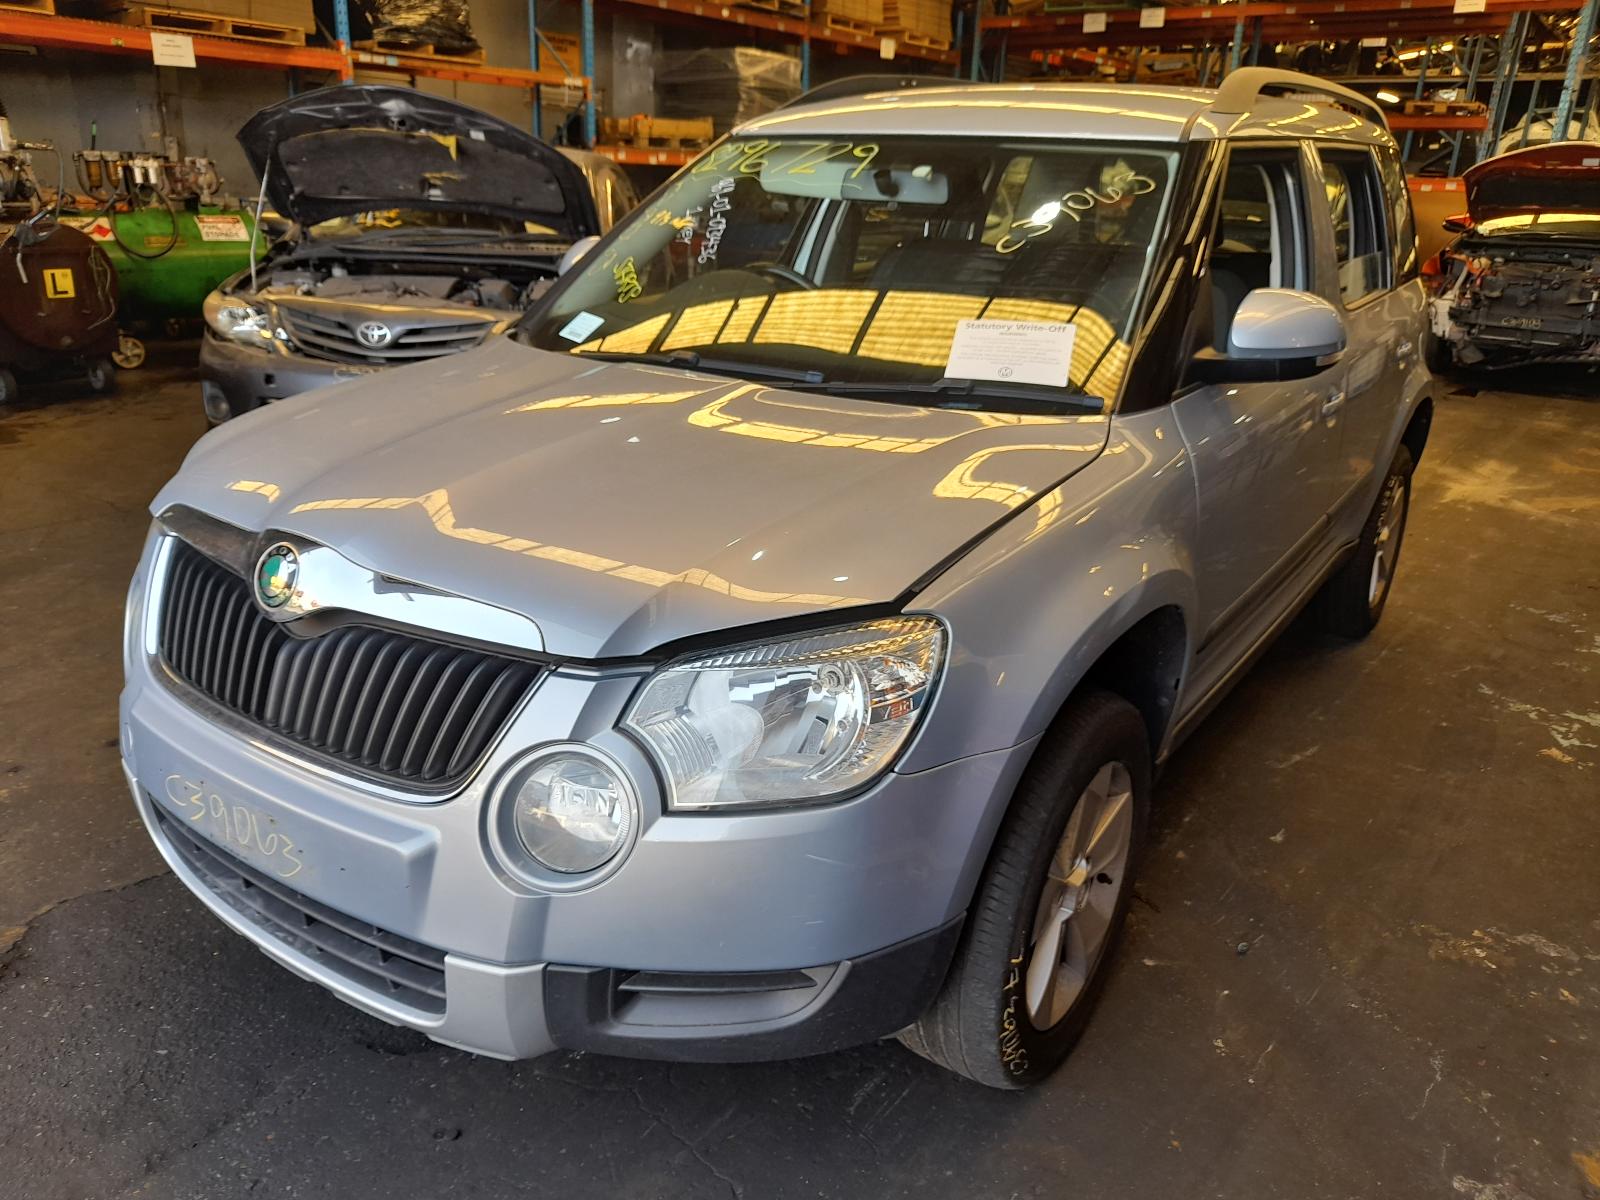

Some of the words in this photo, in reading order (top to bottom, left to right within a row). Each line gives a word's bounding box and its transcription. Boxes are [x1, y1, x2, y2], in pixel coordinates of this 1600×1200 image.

[50, 272, 69, 296] L
[965, 322, 1013, 331] Statutory
[1015, 323, 1068, 333] Write-Off
[165, 774, 303, 878] C39063
